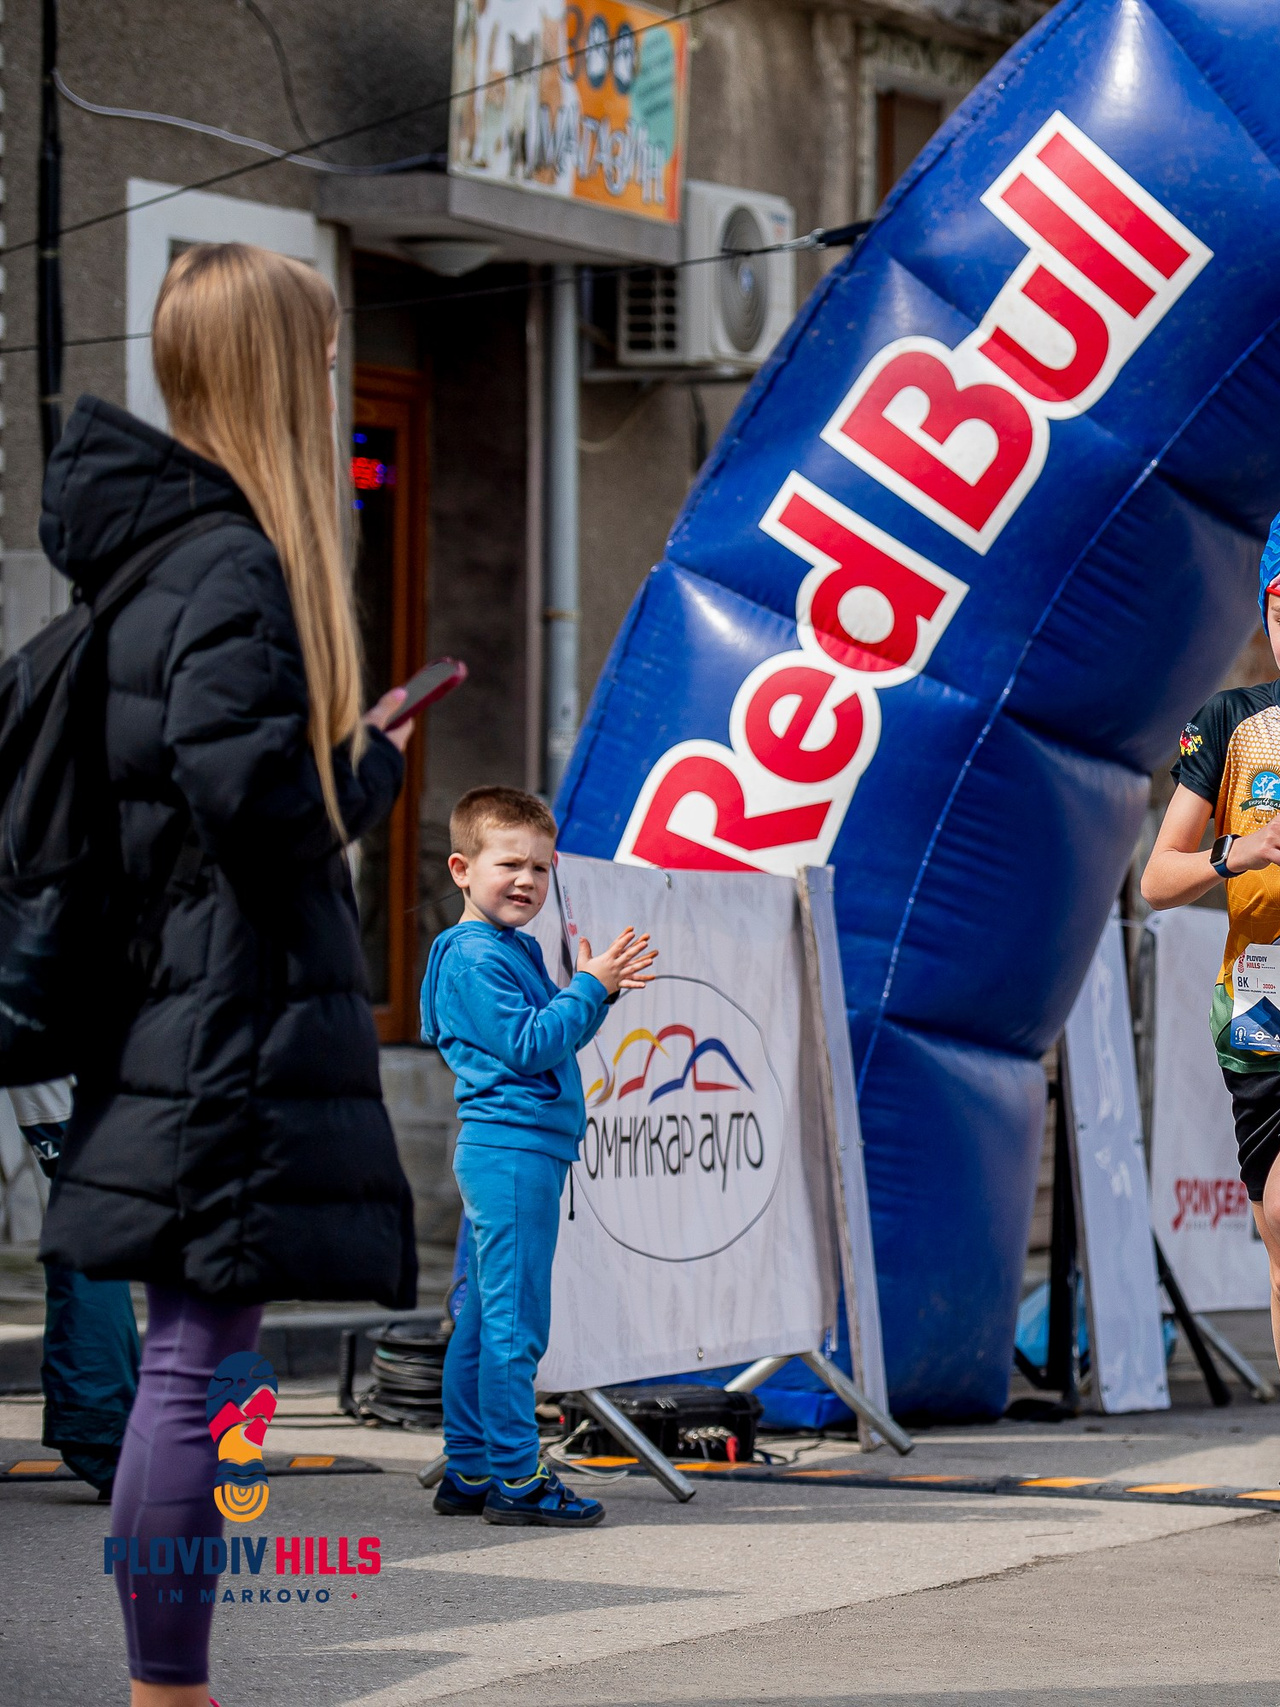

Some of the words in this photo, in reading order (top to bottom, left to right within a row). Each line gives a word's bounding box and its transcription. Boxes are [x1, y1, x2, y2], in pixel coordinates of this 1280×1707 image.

[628, 490, 950, 873] Red
[838, 129, 1194, 536] Bull
[1246, 954, 1268, 963] PLOVDIV
[1246, 962, 1261, 970] HILLS
[1237, 975, 1250, 988] 8K
